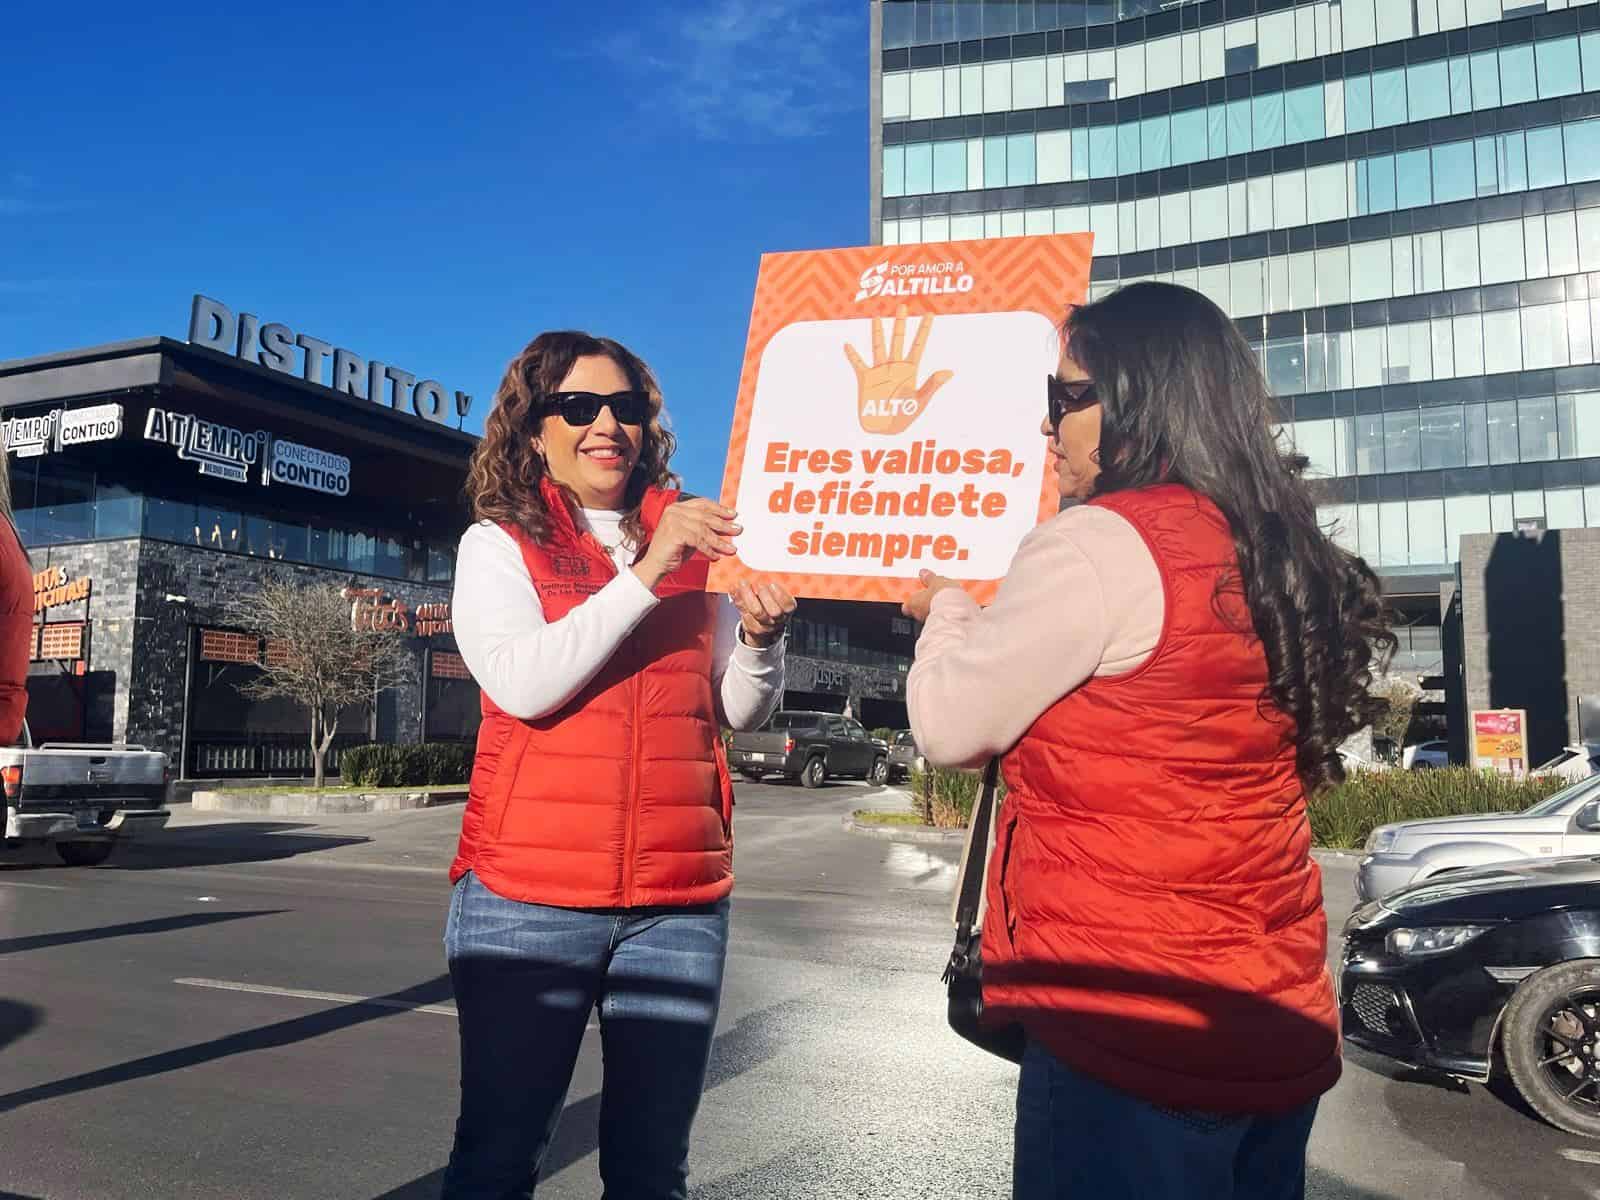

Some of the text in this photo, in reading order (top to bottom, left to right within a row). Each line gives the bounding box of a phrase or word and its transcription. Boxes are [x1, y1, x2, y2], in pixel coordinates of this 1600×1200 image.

[891, 260, 965, 275] POR AMOR A
[187, 293, 450, 425] DISTRITO
[862, 399, 918, 417] ALTO
[62, 420, 116, 441] CONTIGO
[273, 442, 349, 475] CONECTADOS
[764, 440, 1025, 477] Eres valiosa,
[273, 460, 347, 493] CONTIGO
[768, 480, 1008, 518] defiéndete
[787, 521, 969, 567] siempre.
